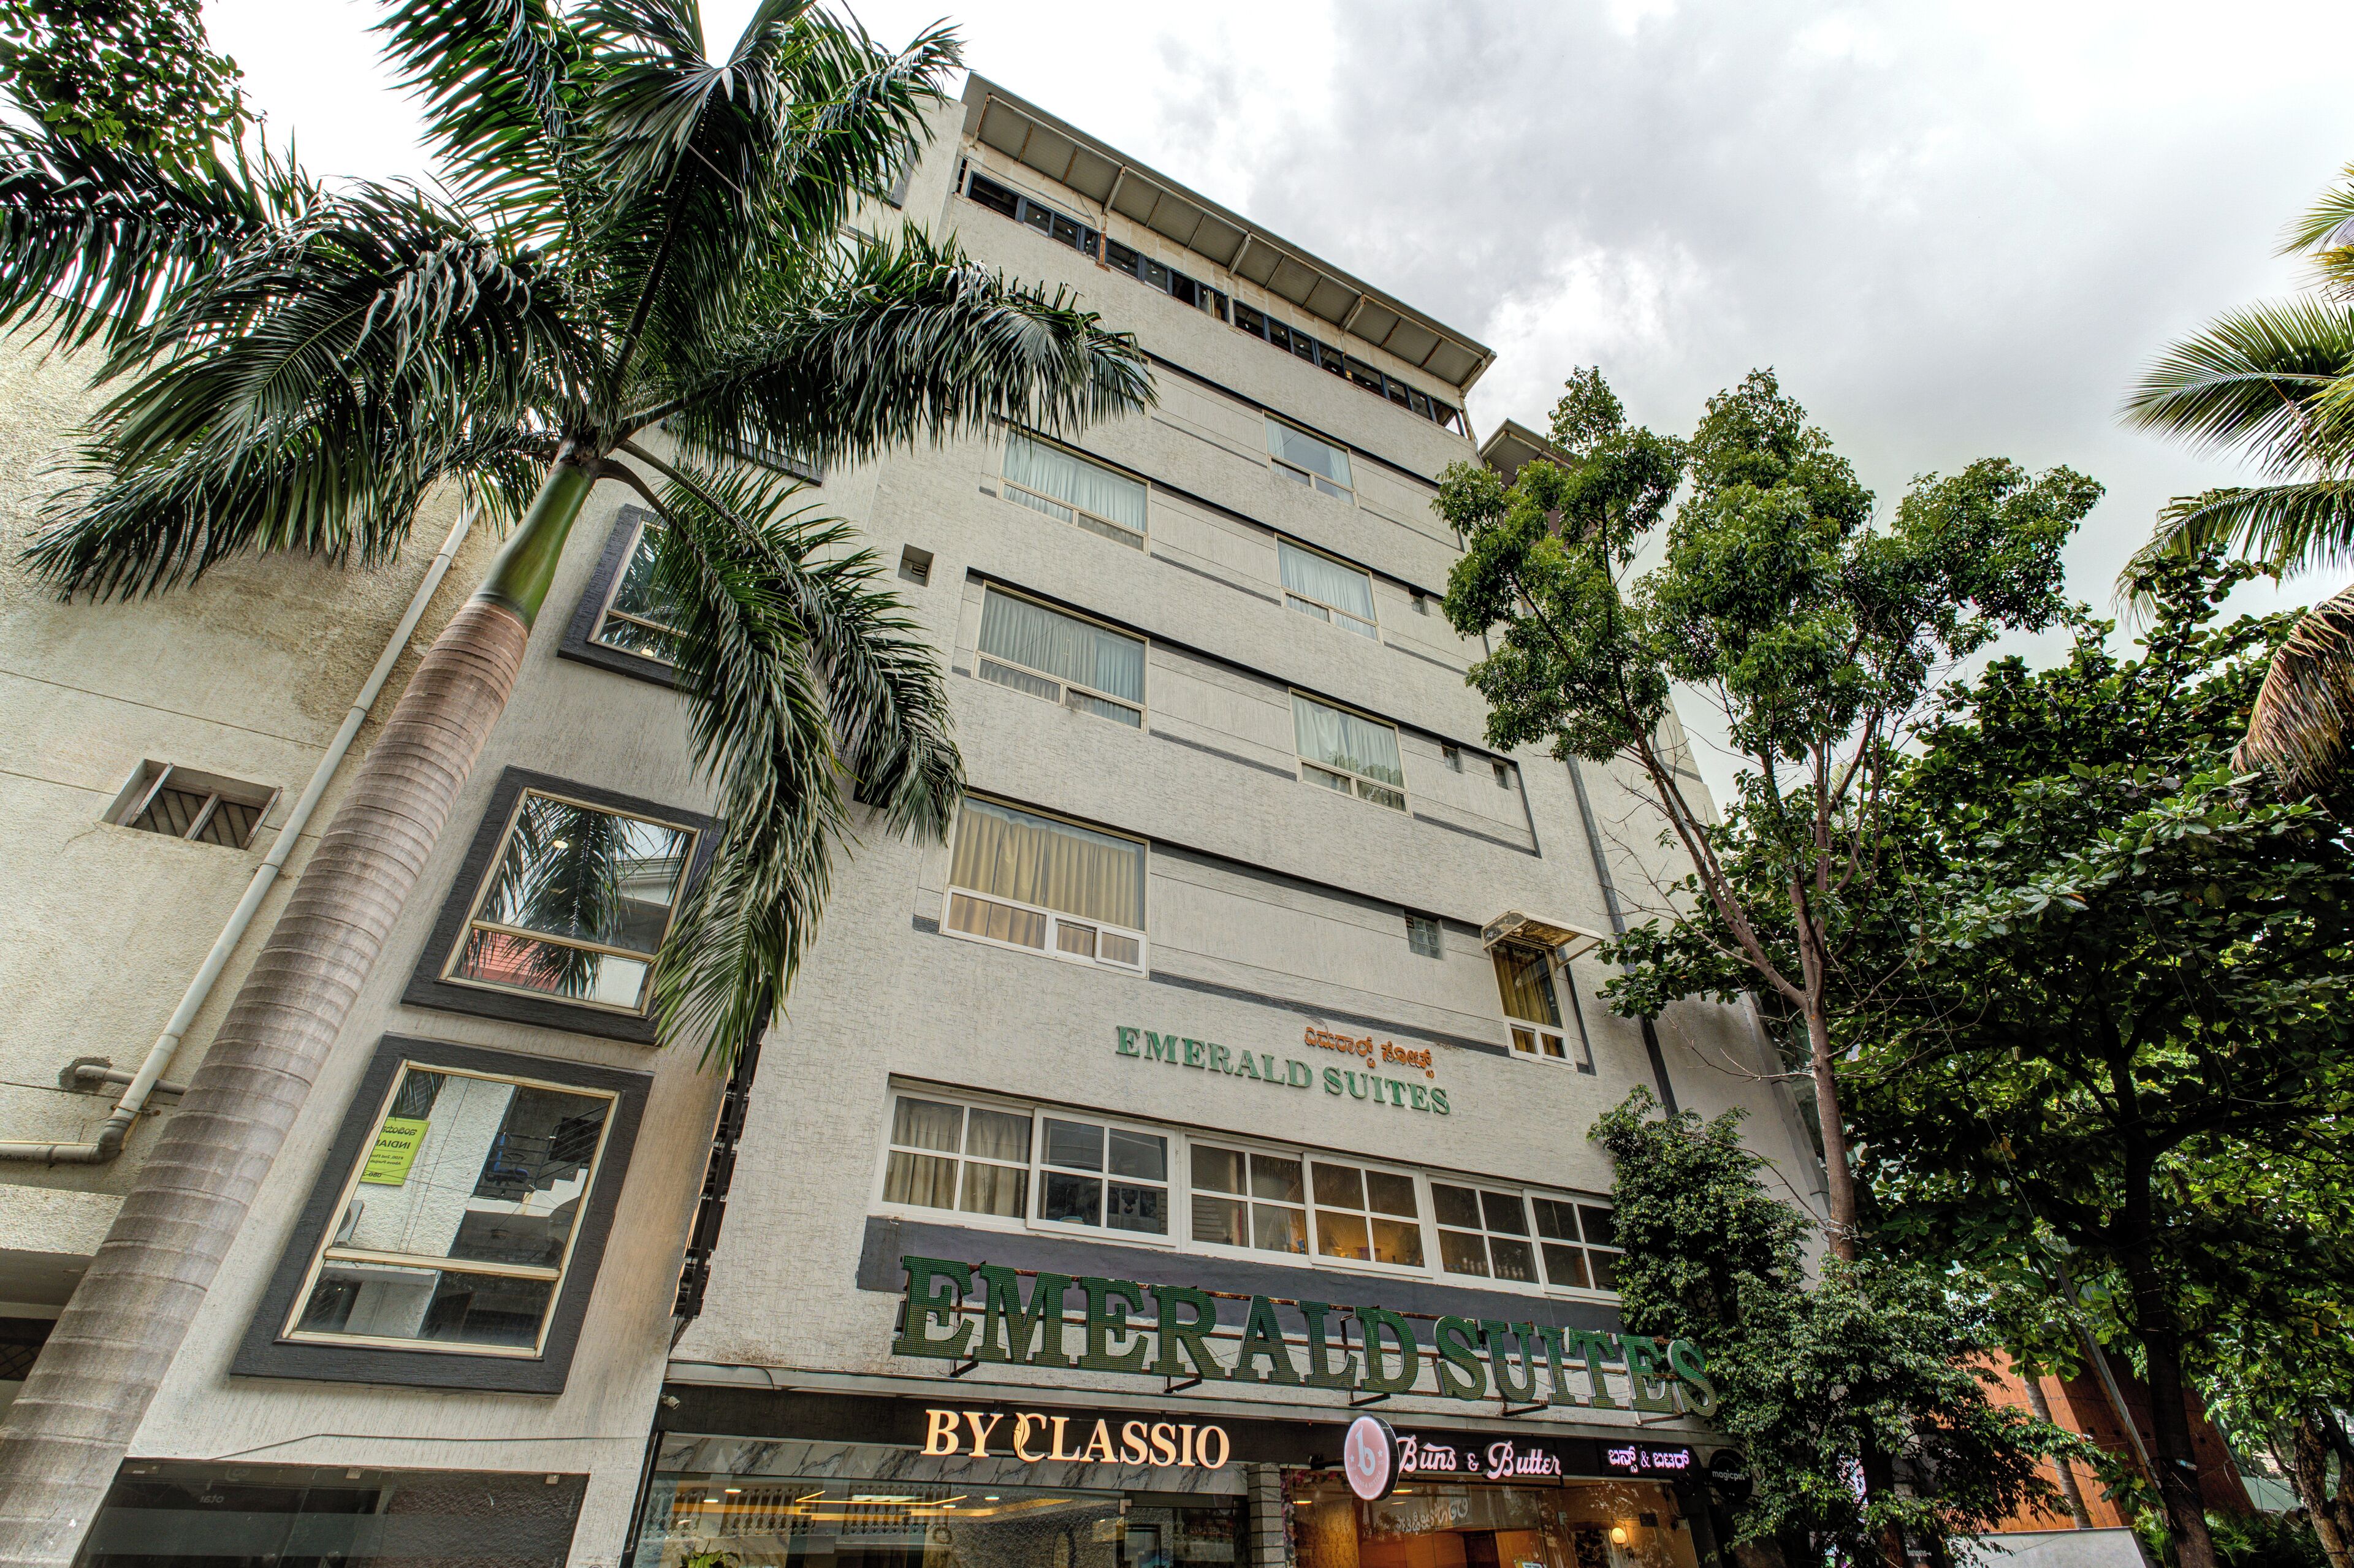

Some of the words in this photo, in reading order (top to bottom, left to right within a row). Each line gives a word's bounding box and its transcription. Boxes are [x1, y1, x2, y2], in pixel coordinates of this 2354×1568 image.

[1116, 1025, 1313, 1088] EMERALD
[1322, 1066, 1451, 1115] SUITES
[893, 1255, 1419, 1394] EMERALD
[1433, 1315, 1717, 1417] SUITES
[920, 1409, 1005, 1458] BY
[1012, 1412, 1230, 1469] CLASSIO
[1396, 1434, 1457, 1473] Buns
[1467, 1453, 1479, 1472] &
[1486, 1441, 1561, 1480] Butter
[1640, 1450, 1651, 1469] &
[1652, 1448, 1690, 1470] ಬಟರ್
